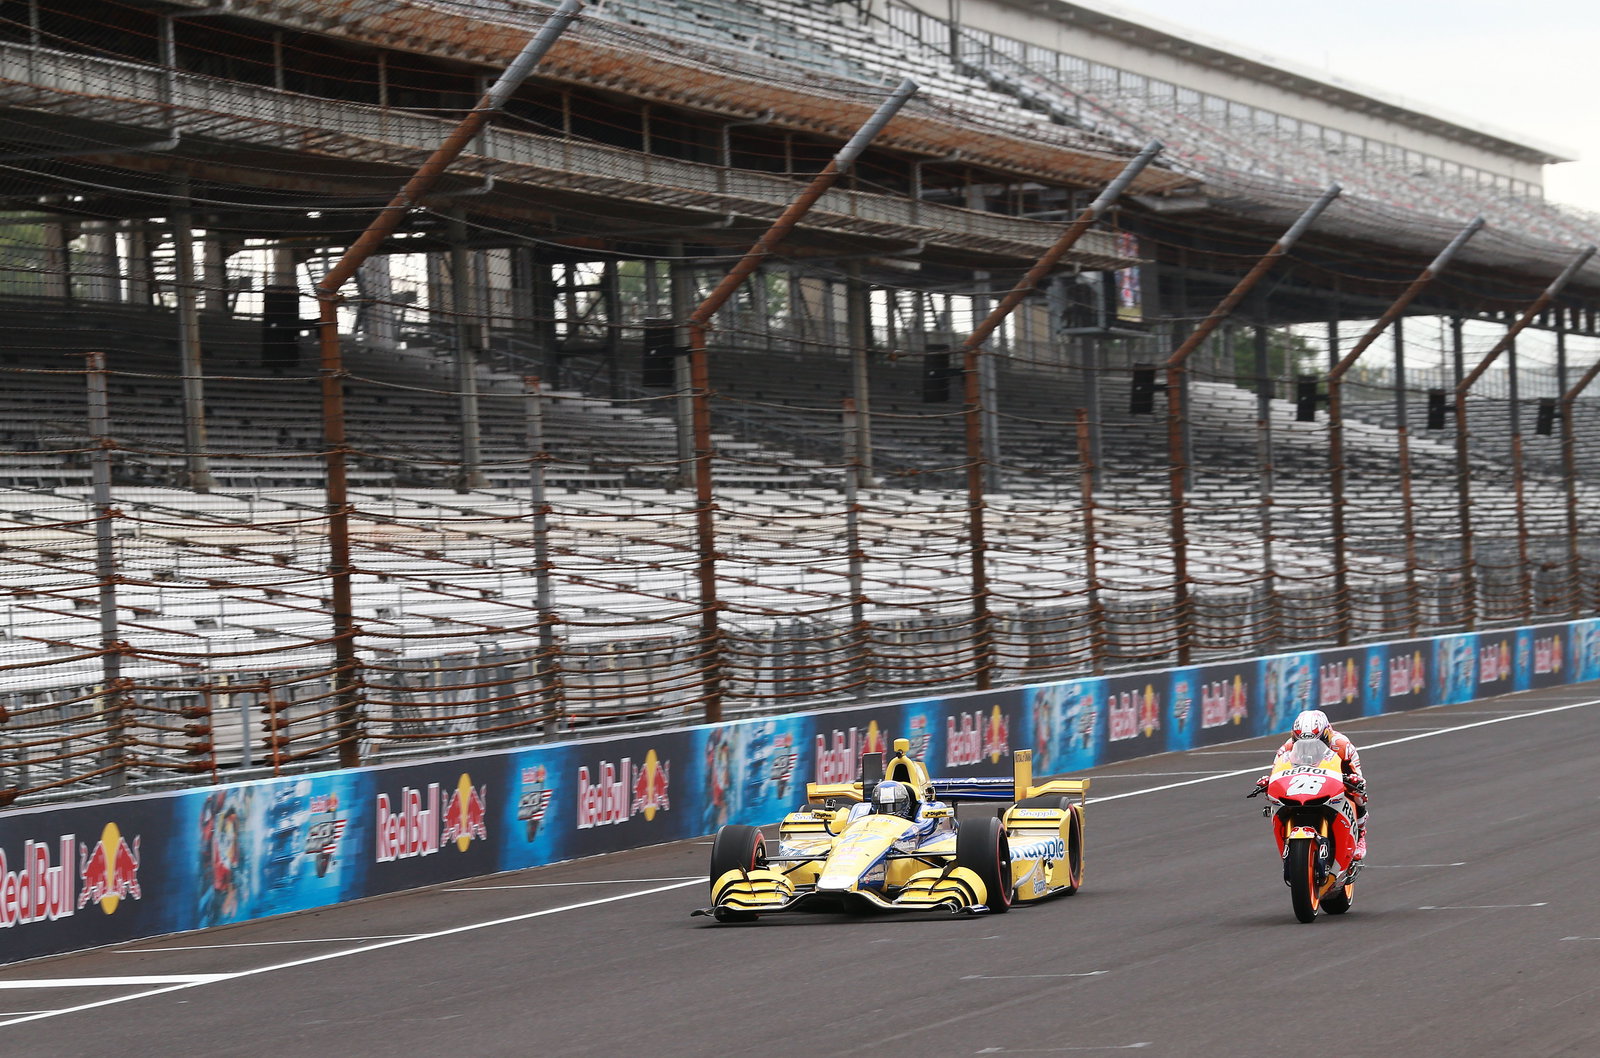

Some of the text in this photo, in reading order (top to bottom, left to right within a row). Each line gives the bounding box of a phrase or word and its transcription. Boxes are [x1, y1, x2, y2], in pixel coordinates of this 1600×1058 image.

[1282, 766, 1328, 777] REPSOL
[1286, 774, 1327, 797] 26
[1019, 809, 1058, 820] Snapple
